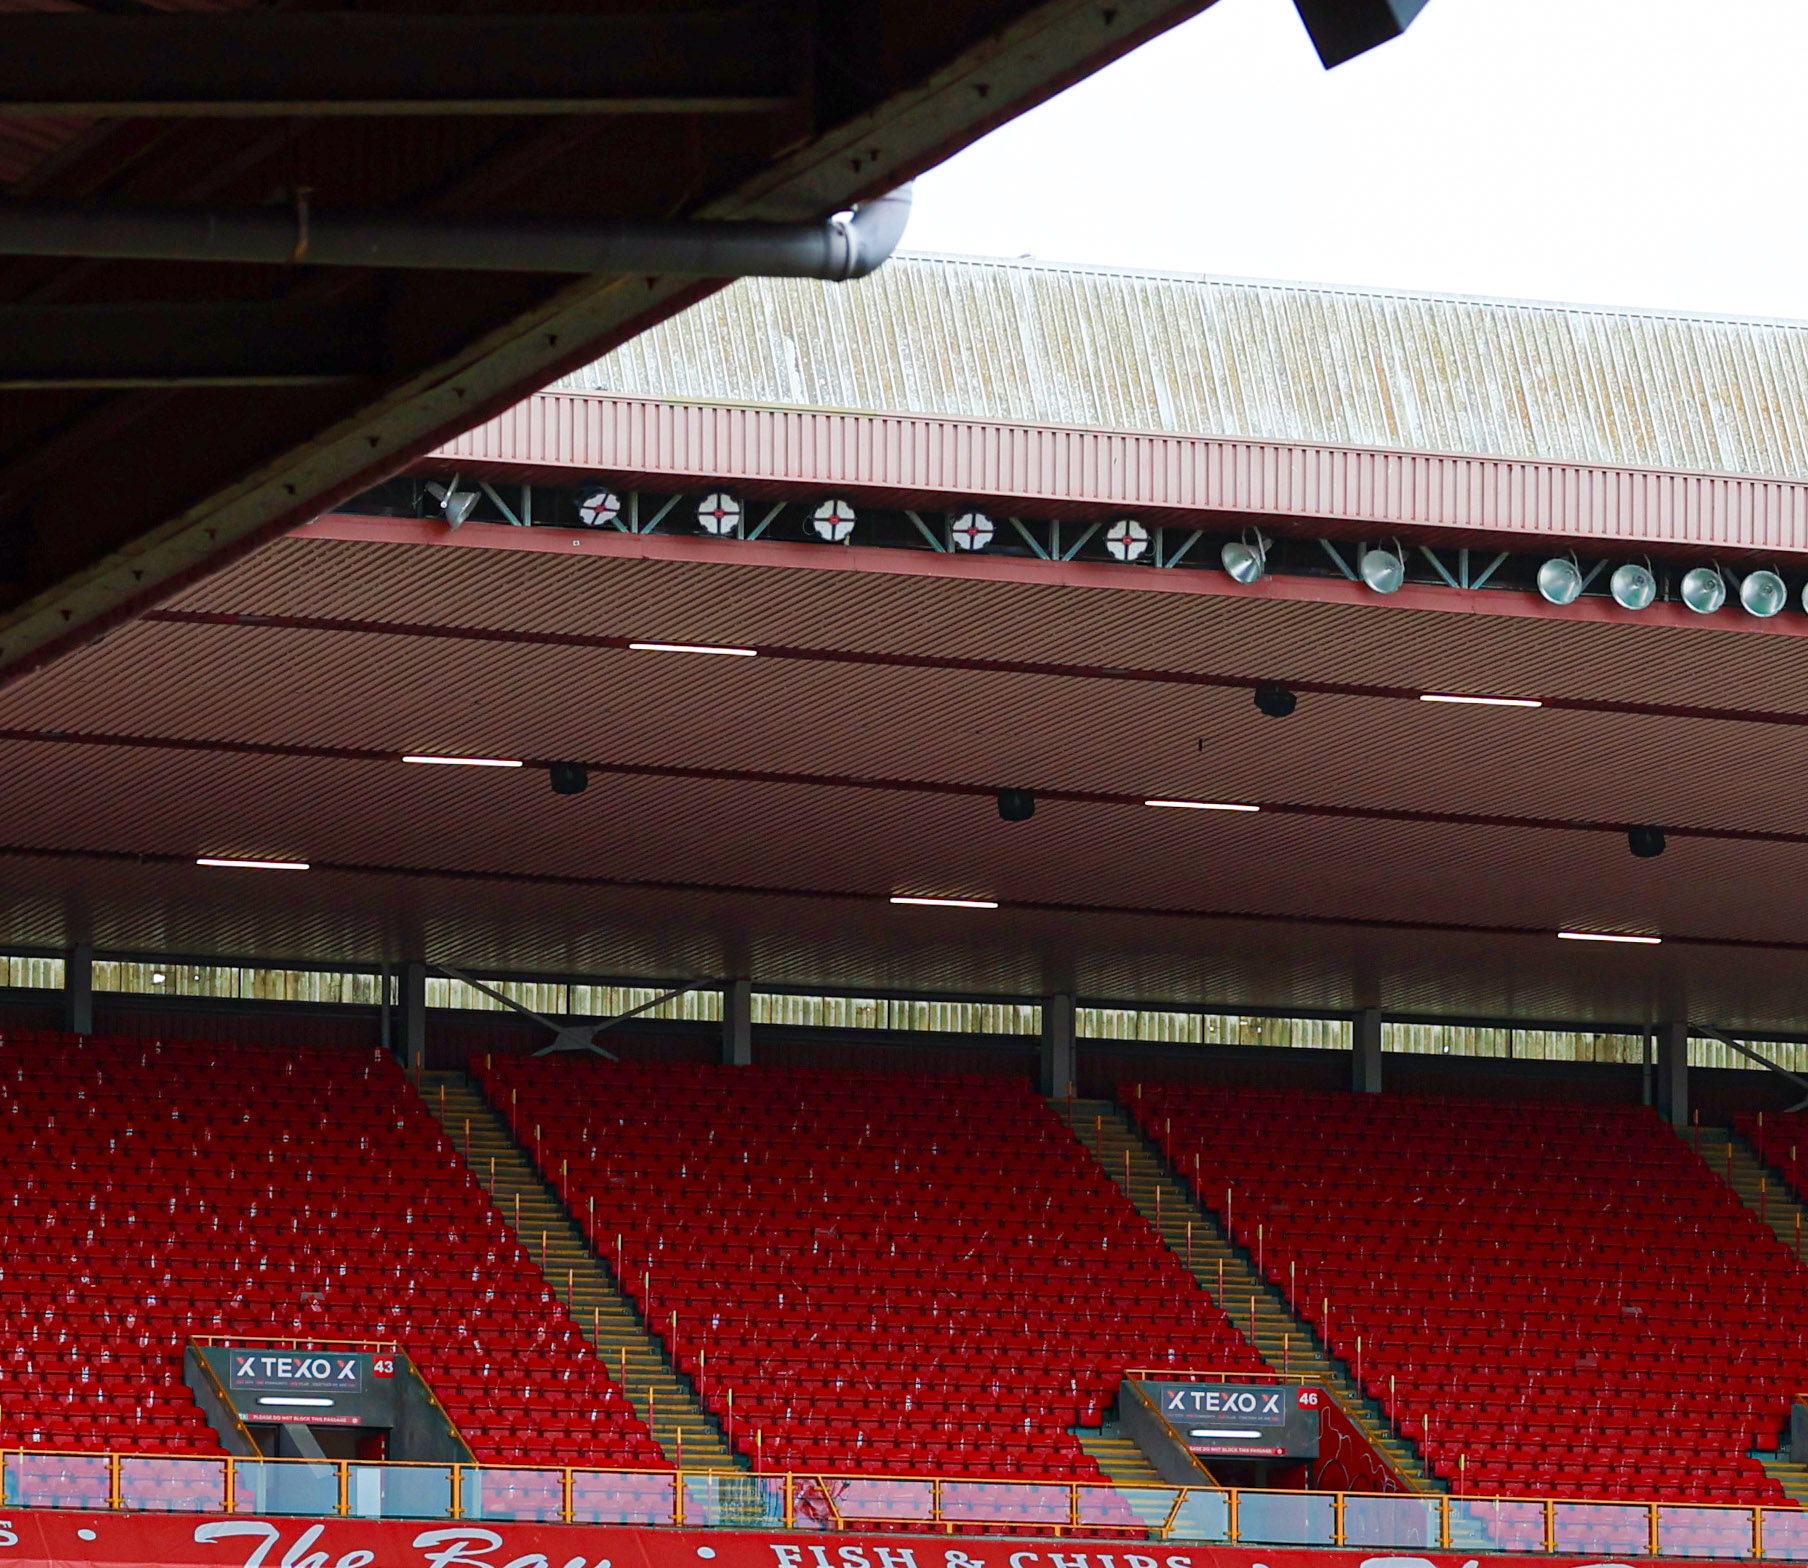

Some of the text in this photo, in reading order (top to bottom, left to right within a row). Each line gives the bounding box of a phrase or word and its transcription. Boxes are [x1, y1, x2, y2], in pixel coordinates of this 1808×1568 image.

[261, 1357, 331, 1379] TEXO
[373, 1360, 393, 1373] 43
[1191, 1391, 1256, 1412] TEXO
[1299, 1392, 1318, 1405] 46
